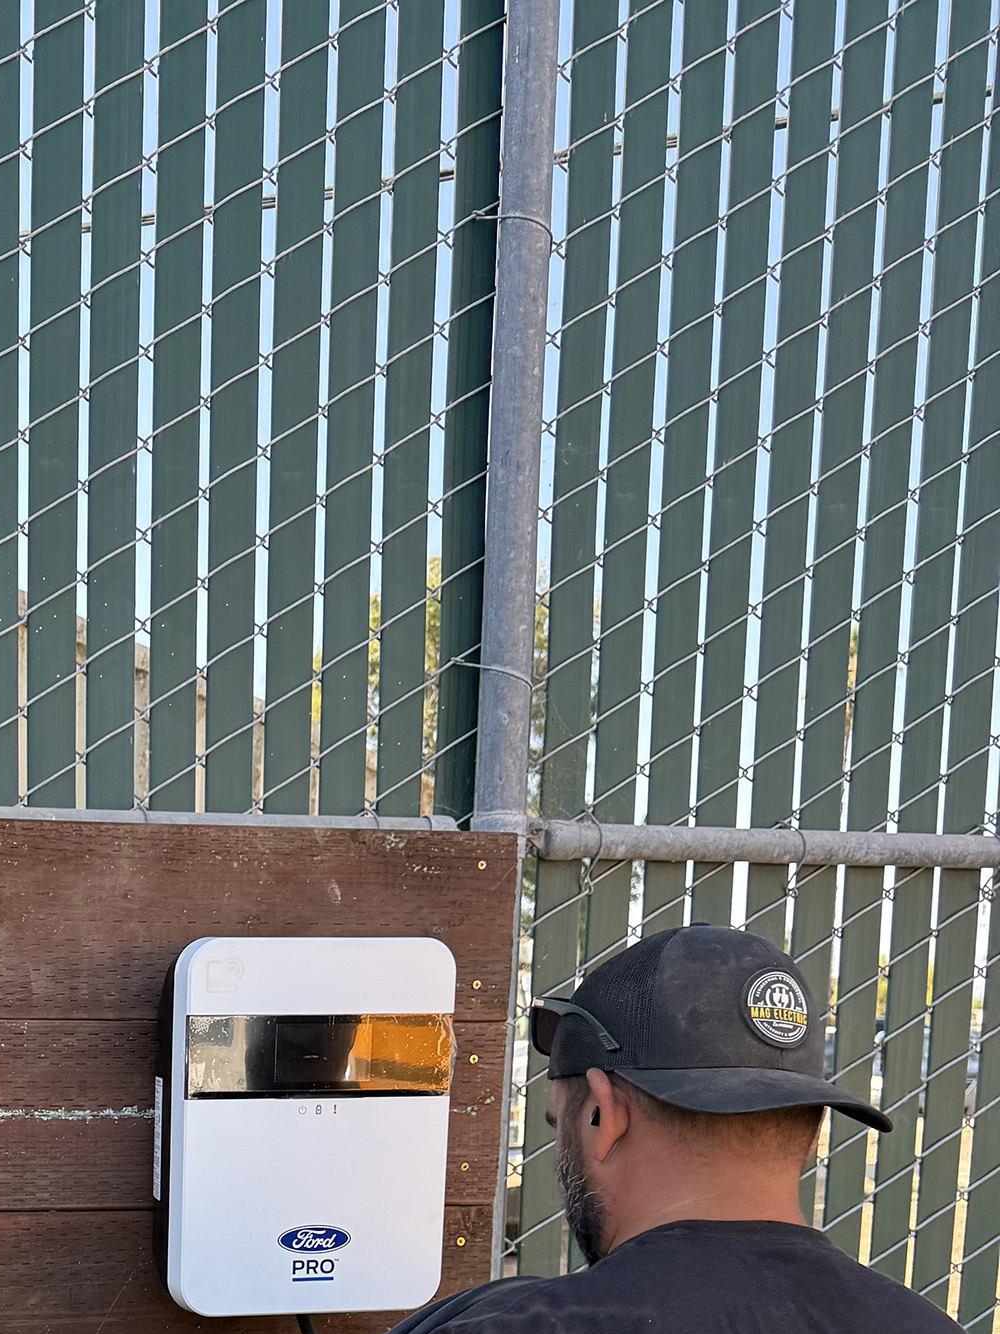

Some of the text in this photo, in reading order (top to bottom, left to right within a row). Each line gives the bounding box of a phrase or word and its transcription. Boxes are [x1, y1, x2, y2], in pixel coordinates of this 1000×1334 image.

[750, 1006, 771, 1019] MAG
[773, 1008, 807, 1026] ELECTRIC
[292, 1229, 337, 1249] Ford
[292, 1258, 335, 1275] PRO
